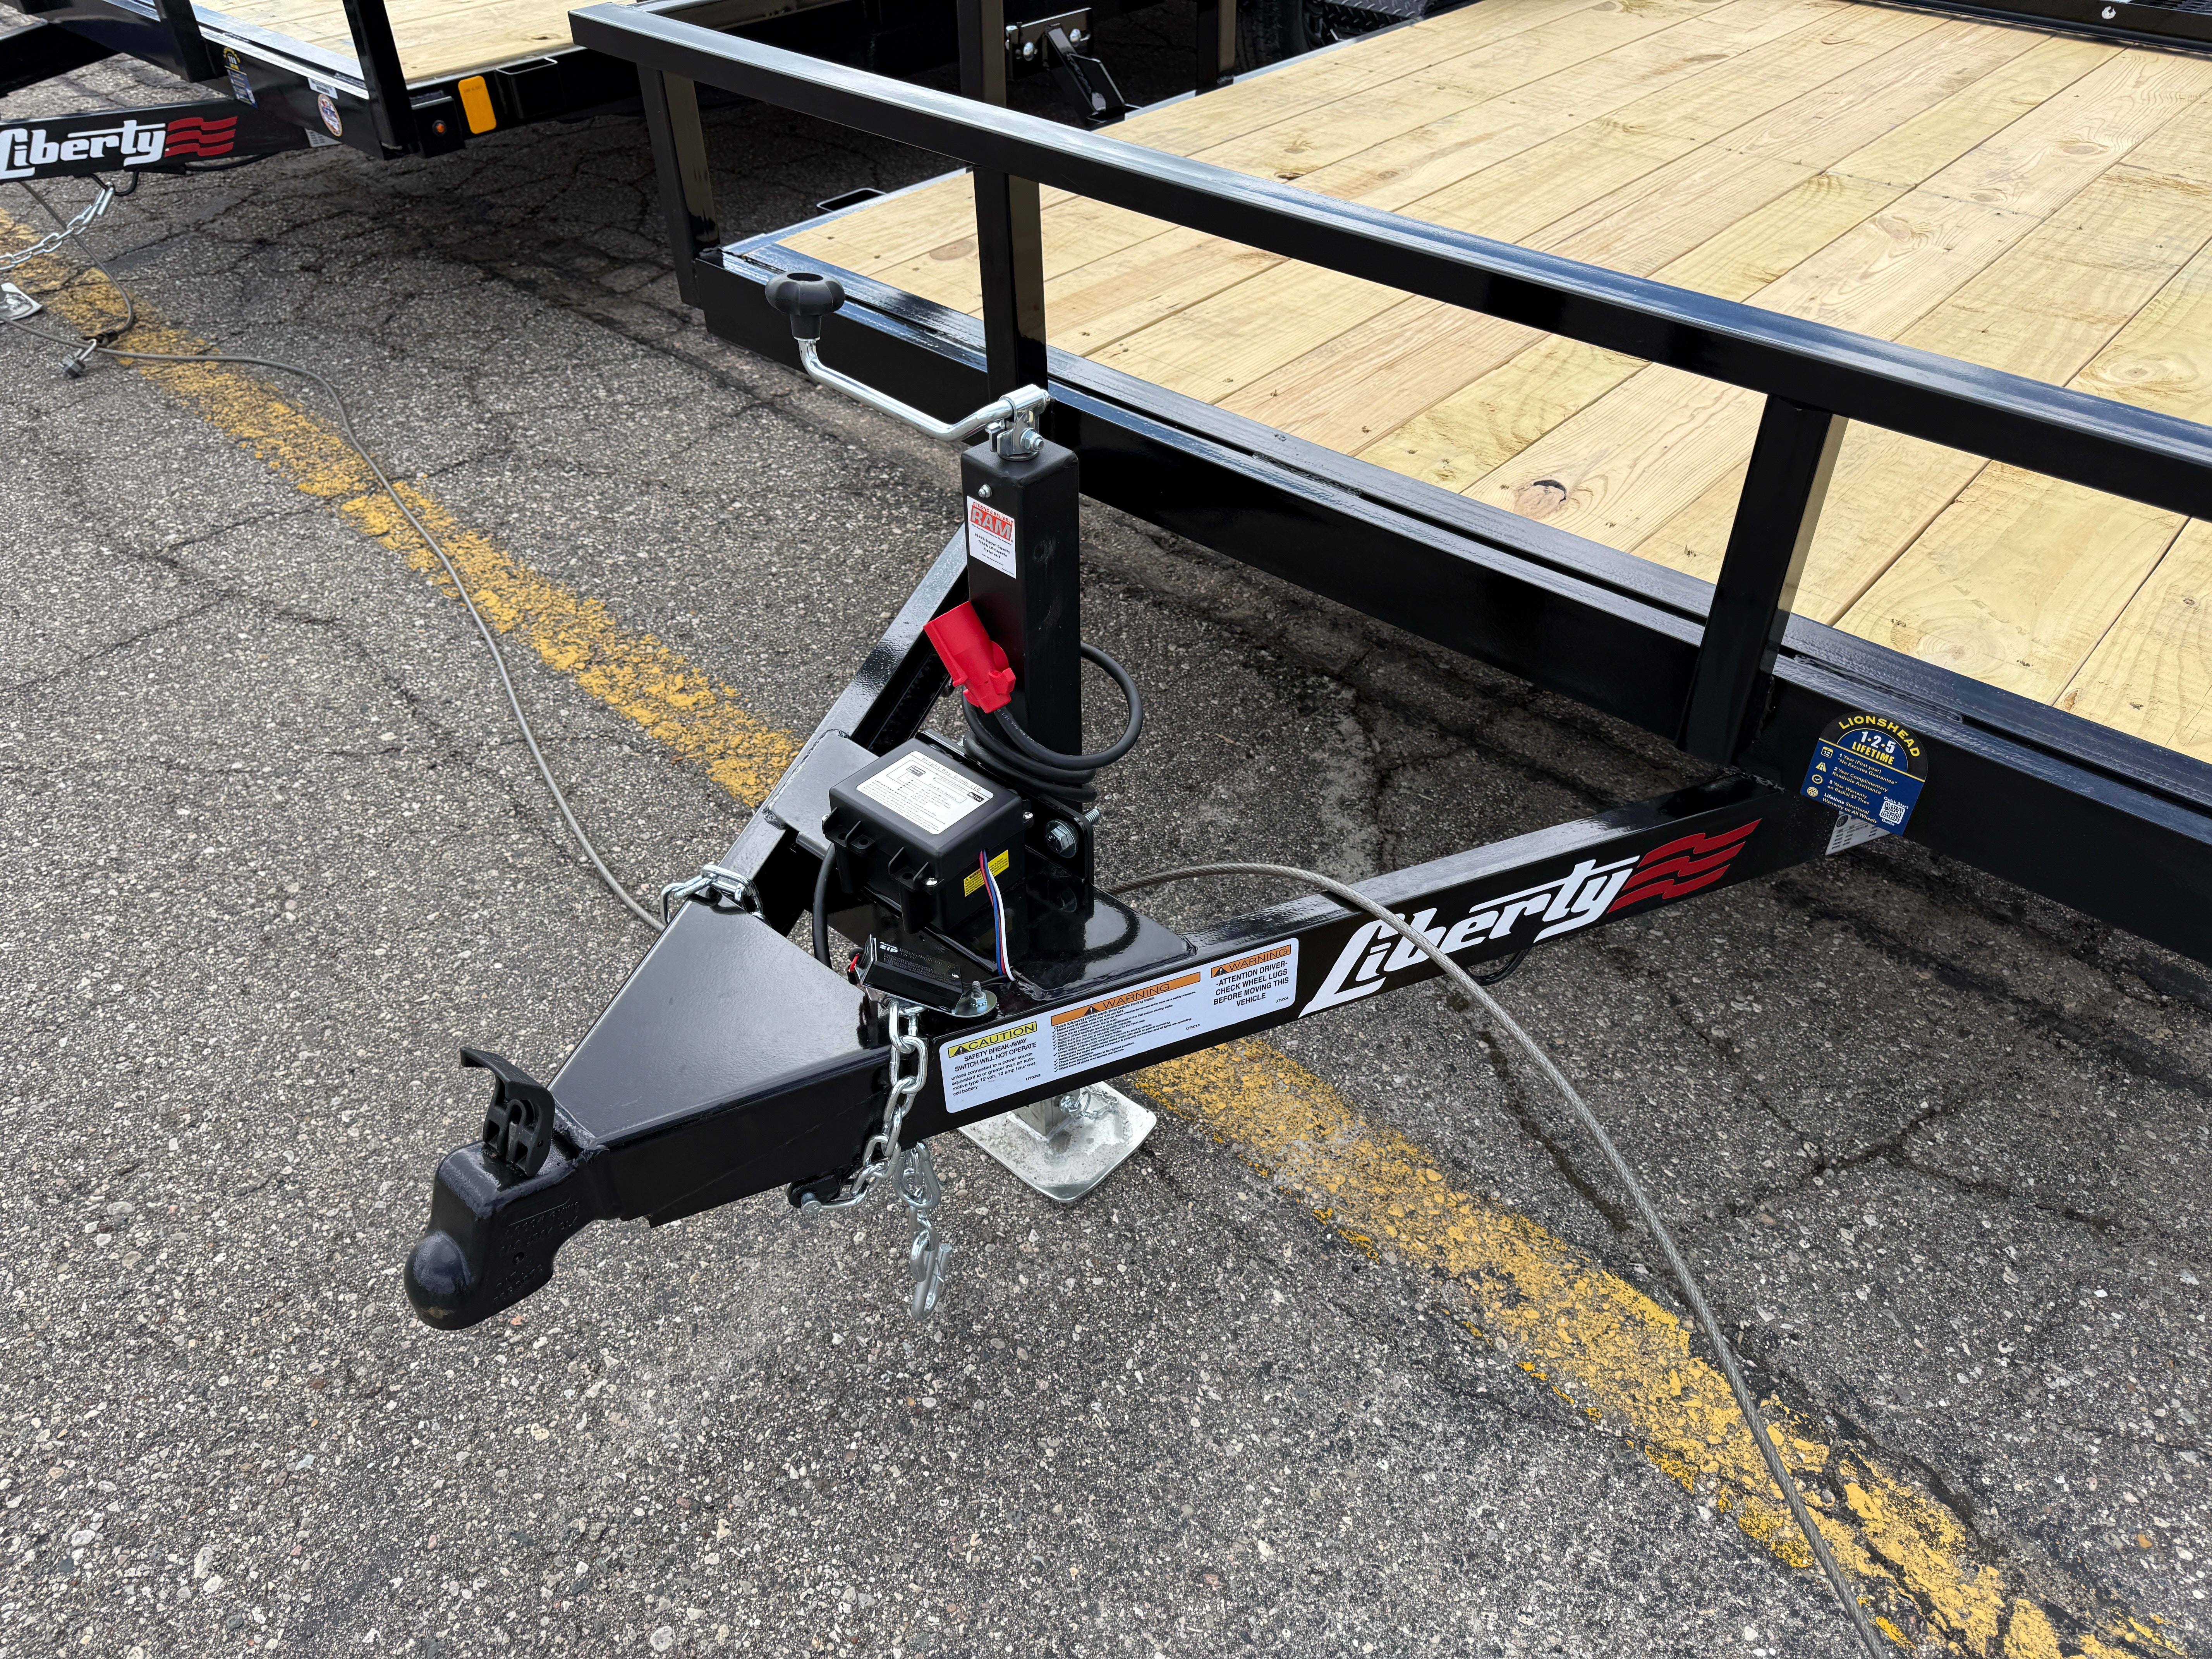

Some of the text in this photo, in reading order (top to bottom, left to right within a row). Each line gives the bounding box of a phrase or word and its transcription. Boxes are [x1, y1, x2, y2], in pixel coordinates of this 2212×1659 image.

[0, 120, 166, 180] Liberty
[971, 507, 1012, 539] RAM
[1838, 716, 1920, 757] LIONSHEAD
[1852, 741, 1894, 765] LIFETIME
[1298, 855, 1639, 1018] Liberty
[1229, 948, 1287, 971] WARNING
[1216, 960, 1288, 986] -ATTENTION DRIVER-
[1216, 969, 1288, 996] CHECK WHEEL LUGS
[1103, 984, 1170, 1009] WARNING
[1213, 977, 1289, 1005] BEFORE MOVING THIS
[1237, 993, 1266, 1006] VEHICLE
[964, 1038, 1027, 1061] SAFETY BREAK-AWAY
[969, 1024, 1034, 1049] CAUTION
[955, 1060, 979, 1072] SWITCH
[980, 1056, 994, 1064] WILL
[1009, 1042, 1036, 1055] OPERATE
